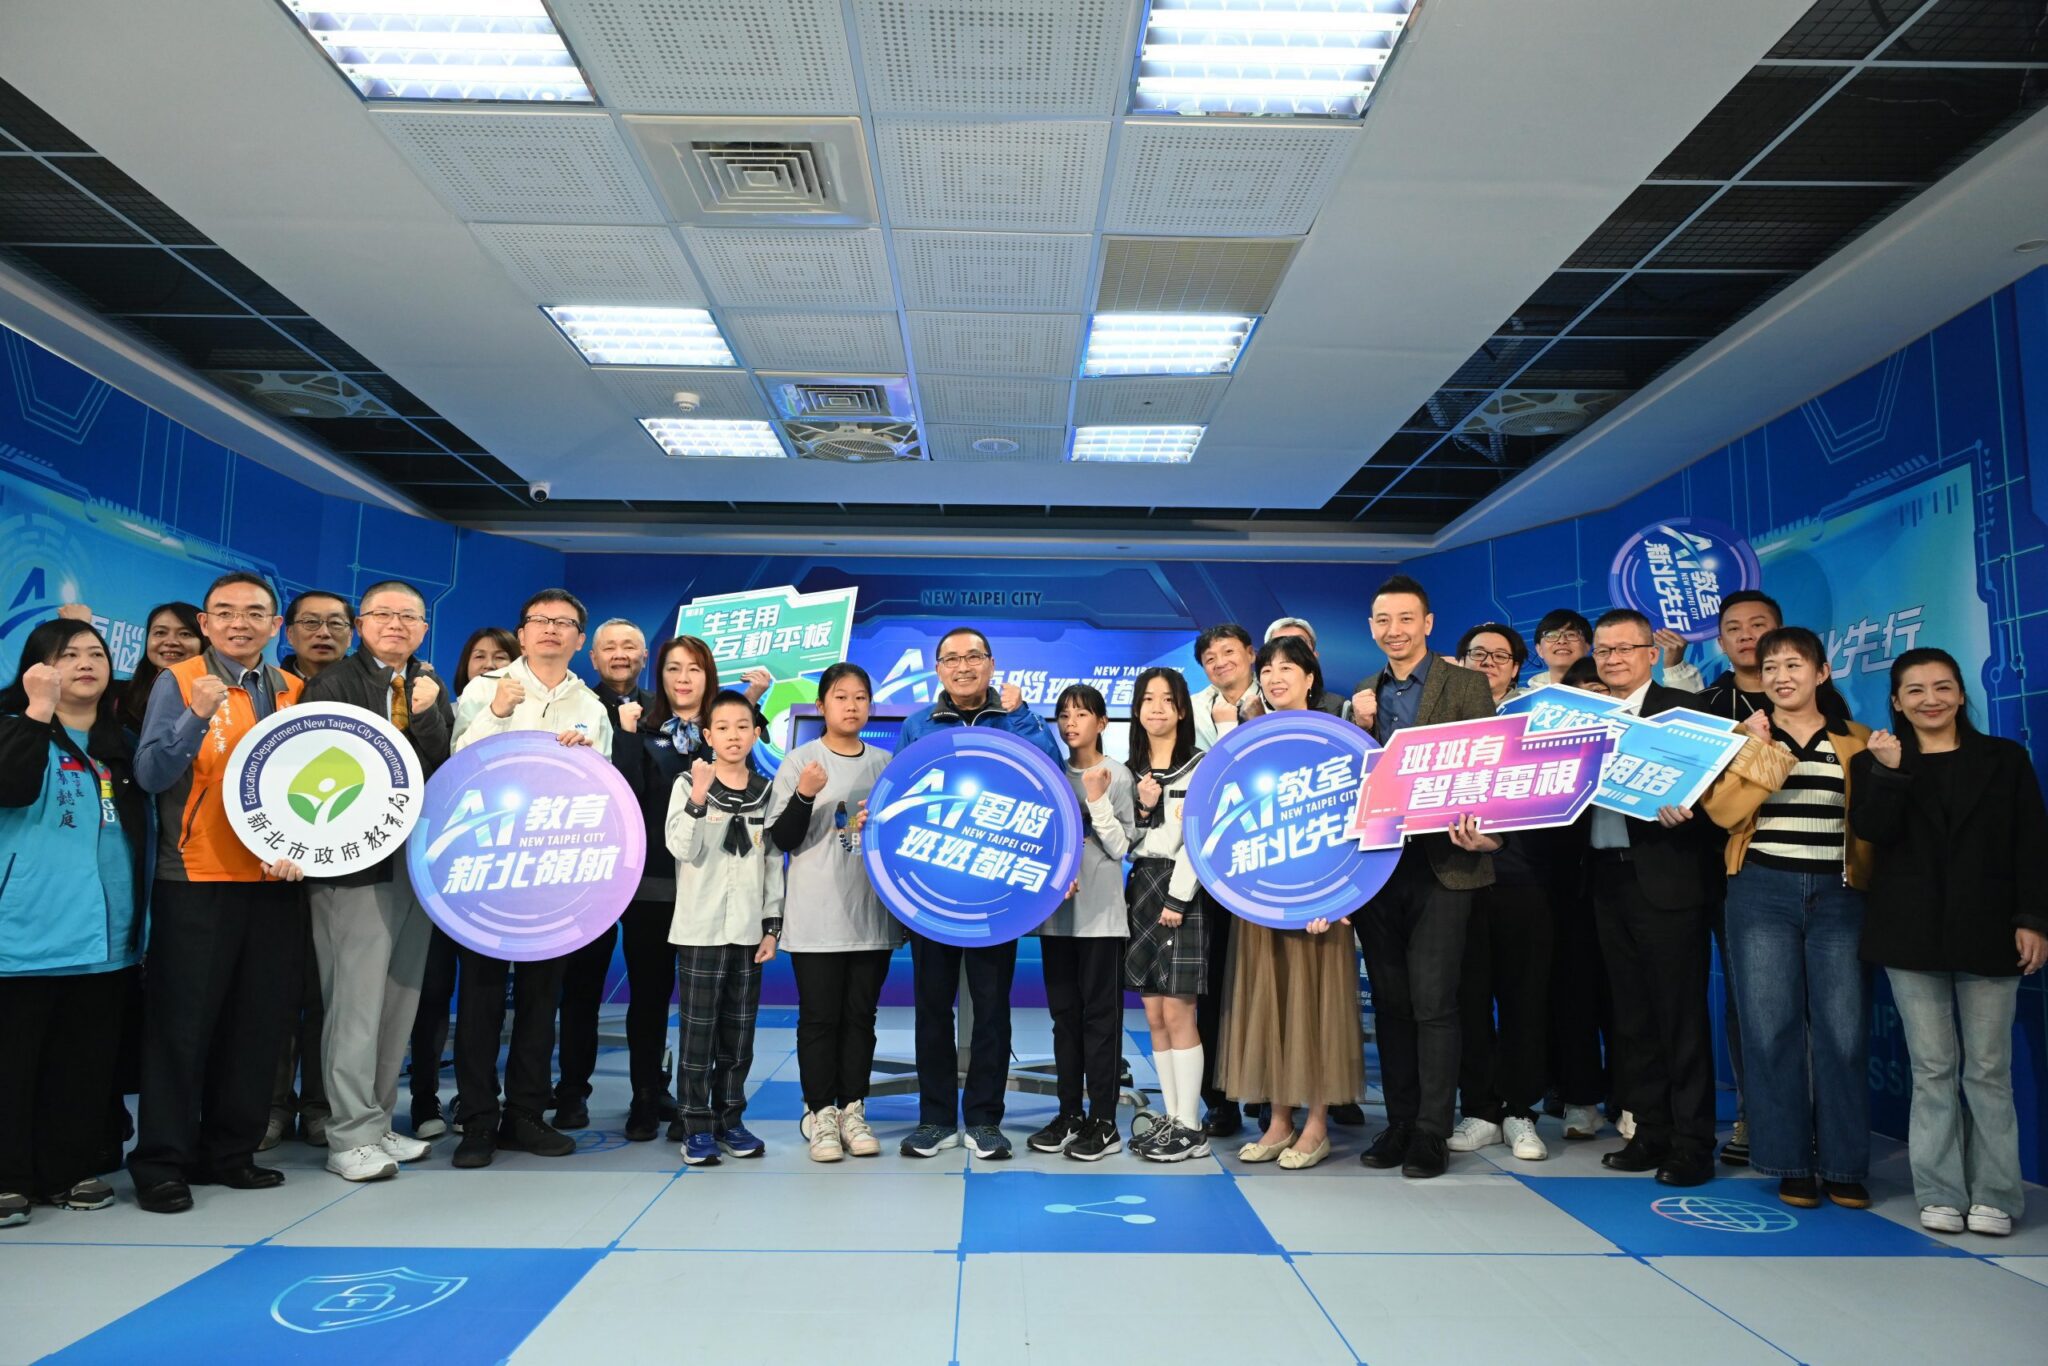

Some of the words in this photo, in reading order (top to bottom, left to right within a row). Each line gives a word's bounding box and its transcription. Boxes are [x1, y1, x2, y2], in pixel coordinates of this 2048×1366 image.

[922, 591, 956, 605] NEW
[960, 591, 1006, 605] TAIPEI
[1011, 591, 1042, 606] CITY
[1644, 539, 1691, 632] 新北先行
[1680, 572, 1690, 586] NEW
[1685, 586, 1696, 608] TAIPEI
[1691, 570, 1722, 619] 教室
[701, 604, 780, 637] 生生用
[1690, 606, 1700, 620] CITY
[712, 620, 833, 662] 互動平板
[1094, 666, 1119, 676] NEW
[245, 760, 260, 806] Education
[253, 722, 303, 761] Department
[303, 719, 326, 729] New
[328, 719, 356, 731] Taipei
[356, 724, 375, 740] City
[373, 735, 405, 785] Government
[1397, 735, 1505, 775] 班班有
[1277, 754, 1358, 808] 教室
[1408, 758, 1581, 810] 智慧電視
[524, 794, 609, 831] 教育
[970, 790, 1055, 839] 電腦
[1281, 808, 1304, 821] NEW
[1306, 797, 1337, 814] TAIPEI
[1340, 789, 1361, 803] CITY
[247, 793, 410, 865] 新北市政府教育局
[519, 836, 545, 847] NEW
[547, 834, 580, 846] TAIPEI
[583, 832, 606, 843] CITY
[962, 826, 985, 840] NEW
[987, 832, 1019, 848] TAIPEI
[1020, 842, 1044, 855] CITY
[442, 846, 621, 894] 新北領航
[896, 825, 1052, 893] 班班都有
